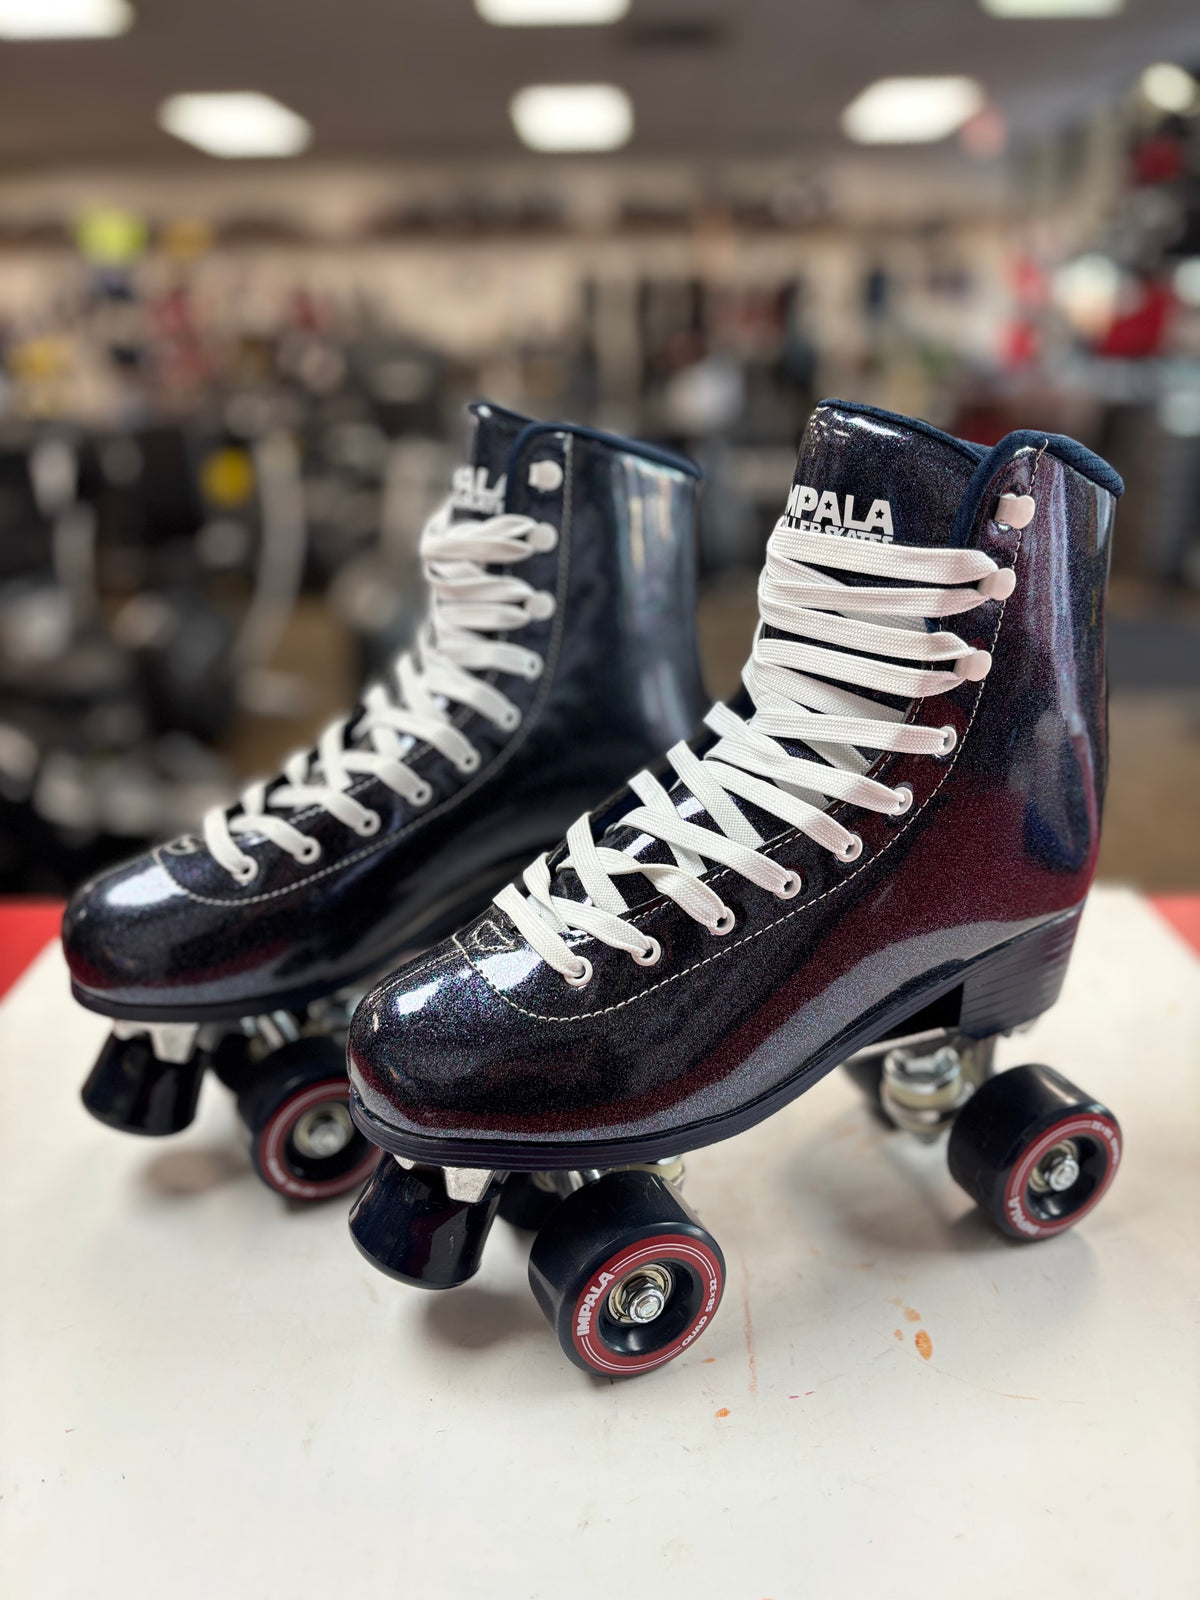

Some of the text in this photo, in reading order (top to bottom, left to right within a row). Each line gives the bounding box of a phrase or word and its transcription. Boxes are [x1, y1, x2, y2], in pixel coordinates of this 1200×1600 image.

[785, 484, 894, 536] MPALA
[577, 1271, 615, 1336] IMPALA
[681, 1315, 708, 1347] QUAD
